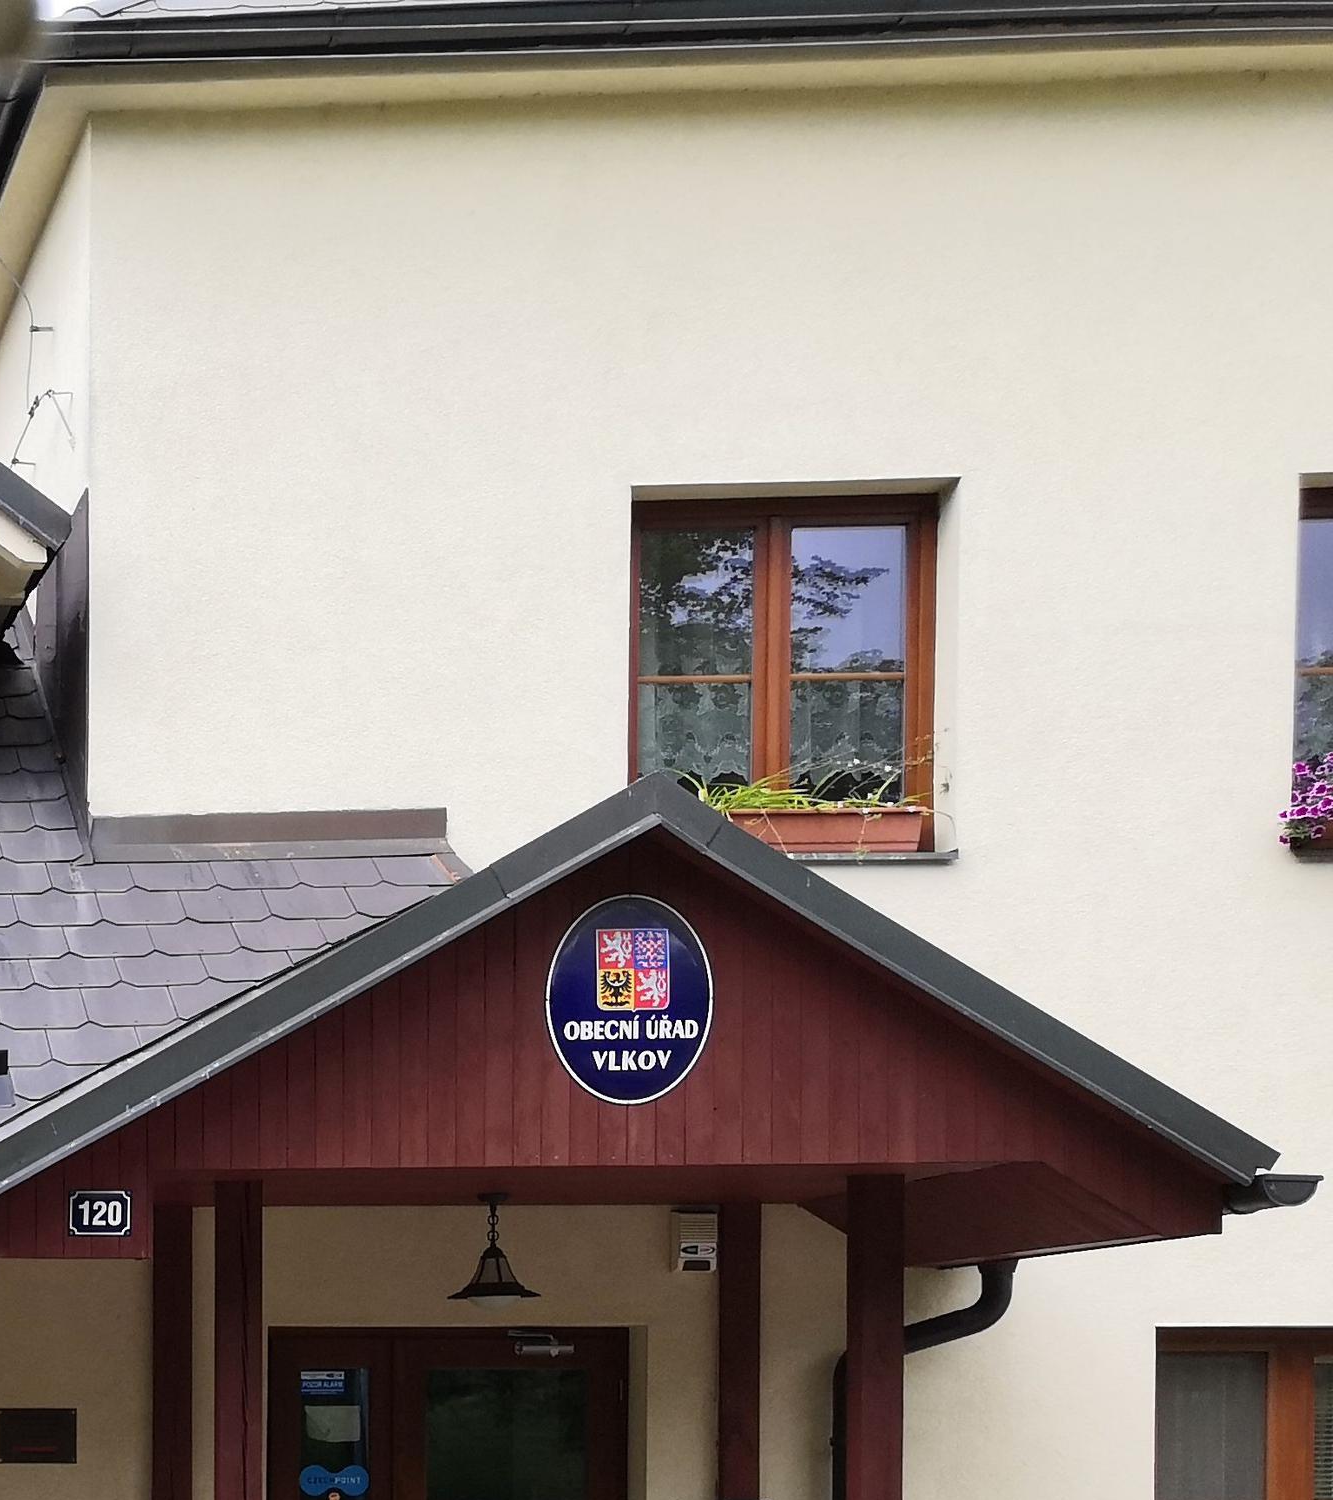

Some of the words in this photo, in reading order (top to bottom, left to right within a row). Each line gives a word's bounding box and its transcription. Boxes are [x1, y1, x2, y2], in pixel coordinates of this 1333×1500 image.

[563, 1014, 639, 1040] OBECNÍ
[645, 1014, 699, 1040] ÚŘAD
[592, 1050, 672, 1071] VLKOV
[78, 1200, 122, 1226] 120
